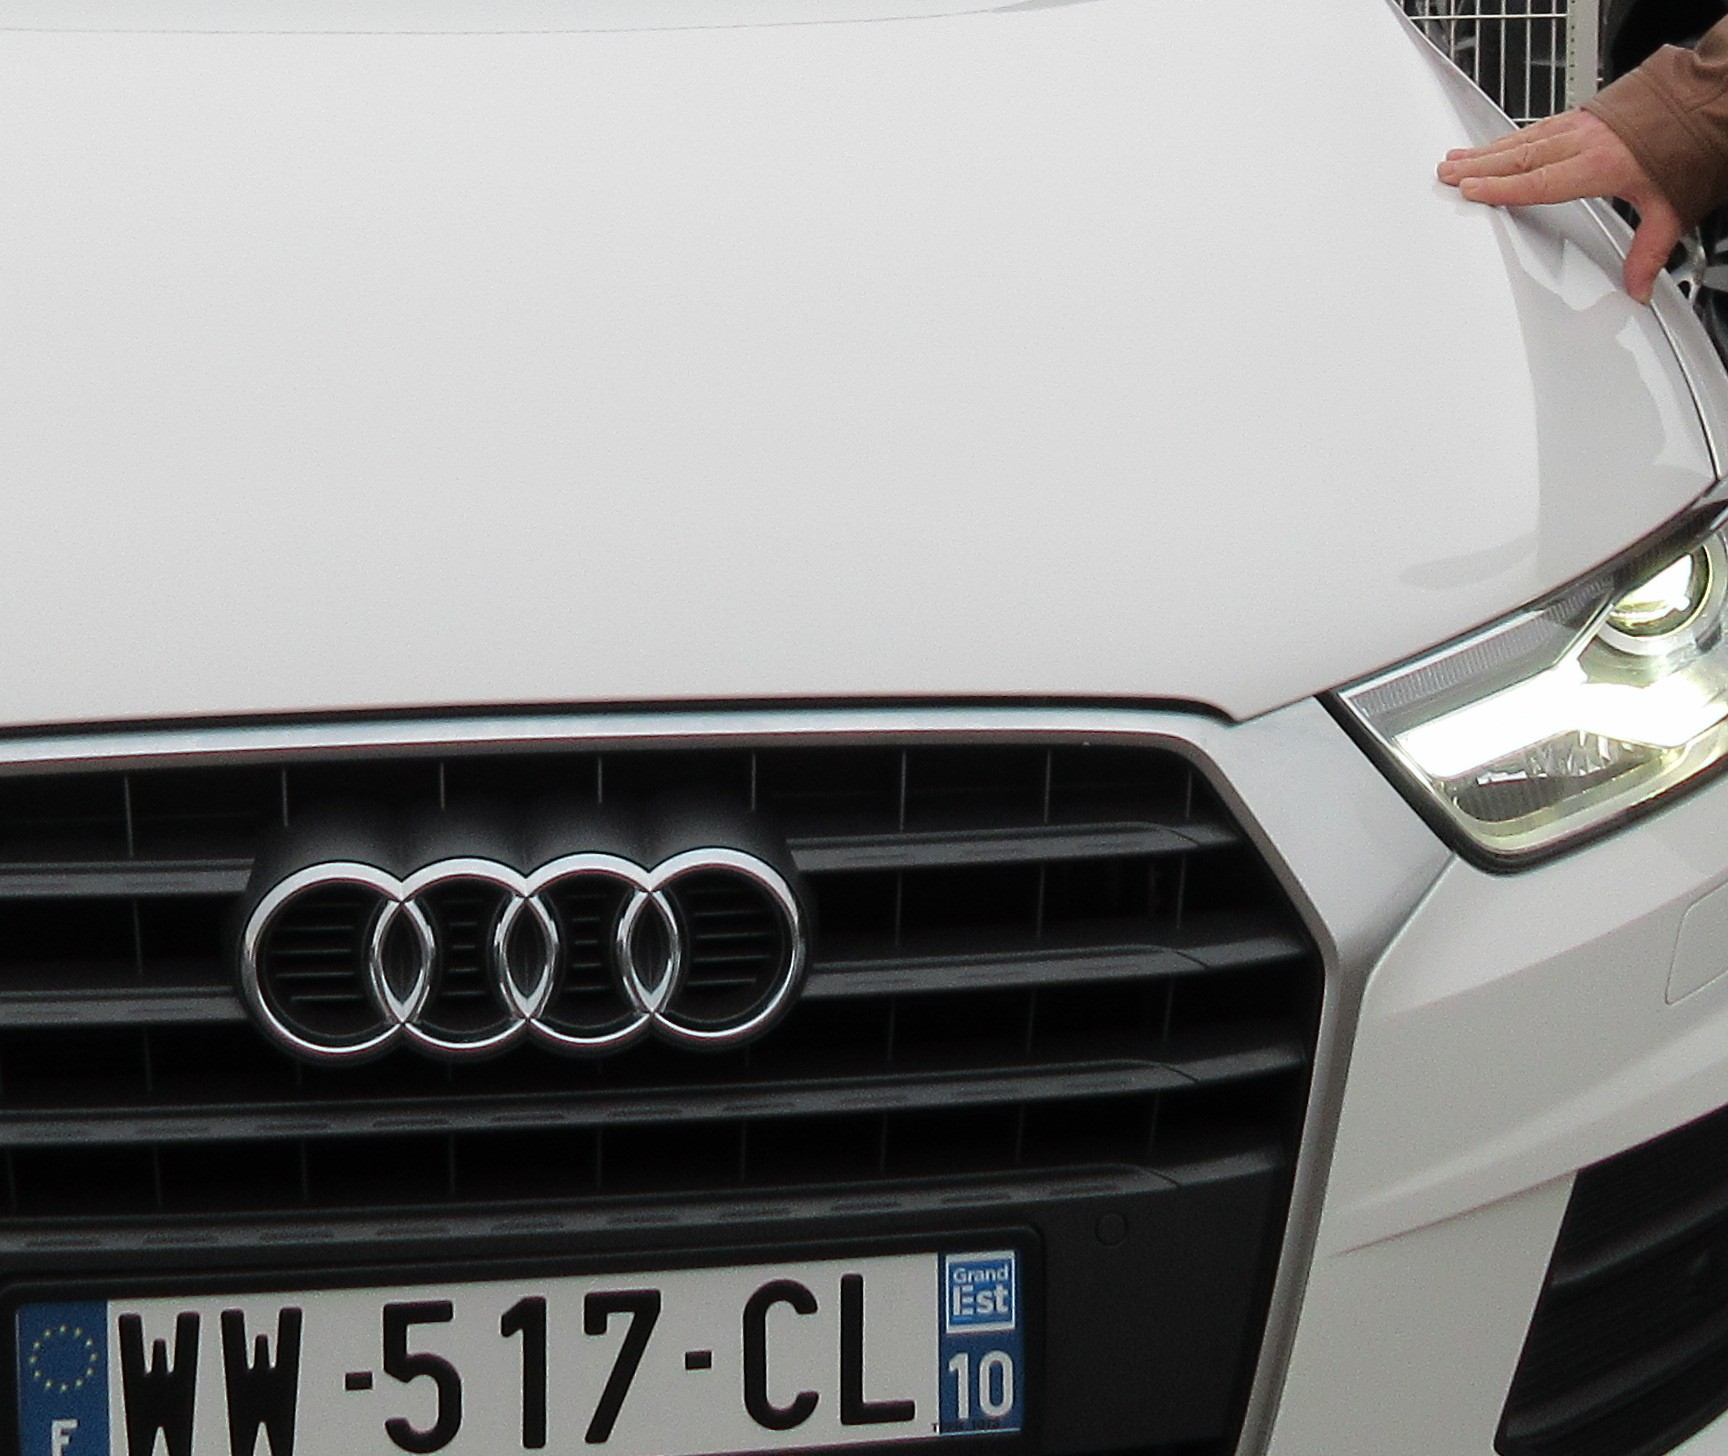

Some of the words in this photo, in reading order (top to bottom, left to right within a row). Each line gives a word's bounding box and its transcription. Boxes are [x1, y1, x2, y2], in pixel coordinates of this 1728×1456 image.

[953, 1263, 1009, 1284] Grand
[953, 1284, 1009, 1316] Est
[948, 1349, 1014, 1420] 10
[51, 1418, 78, 1456] F
